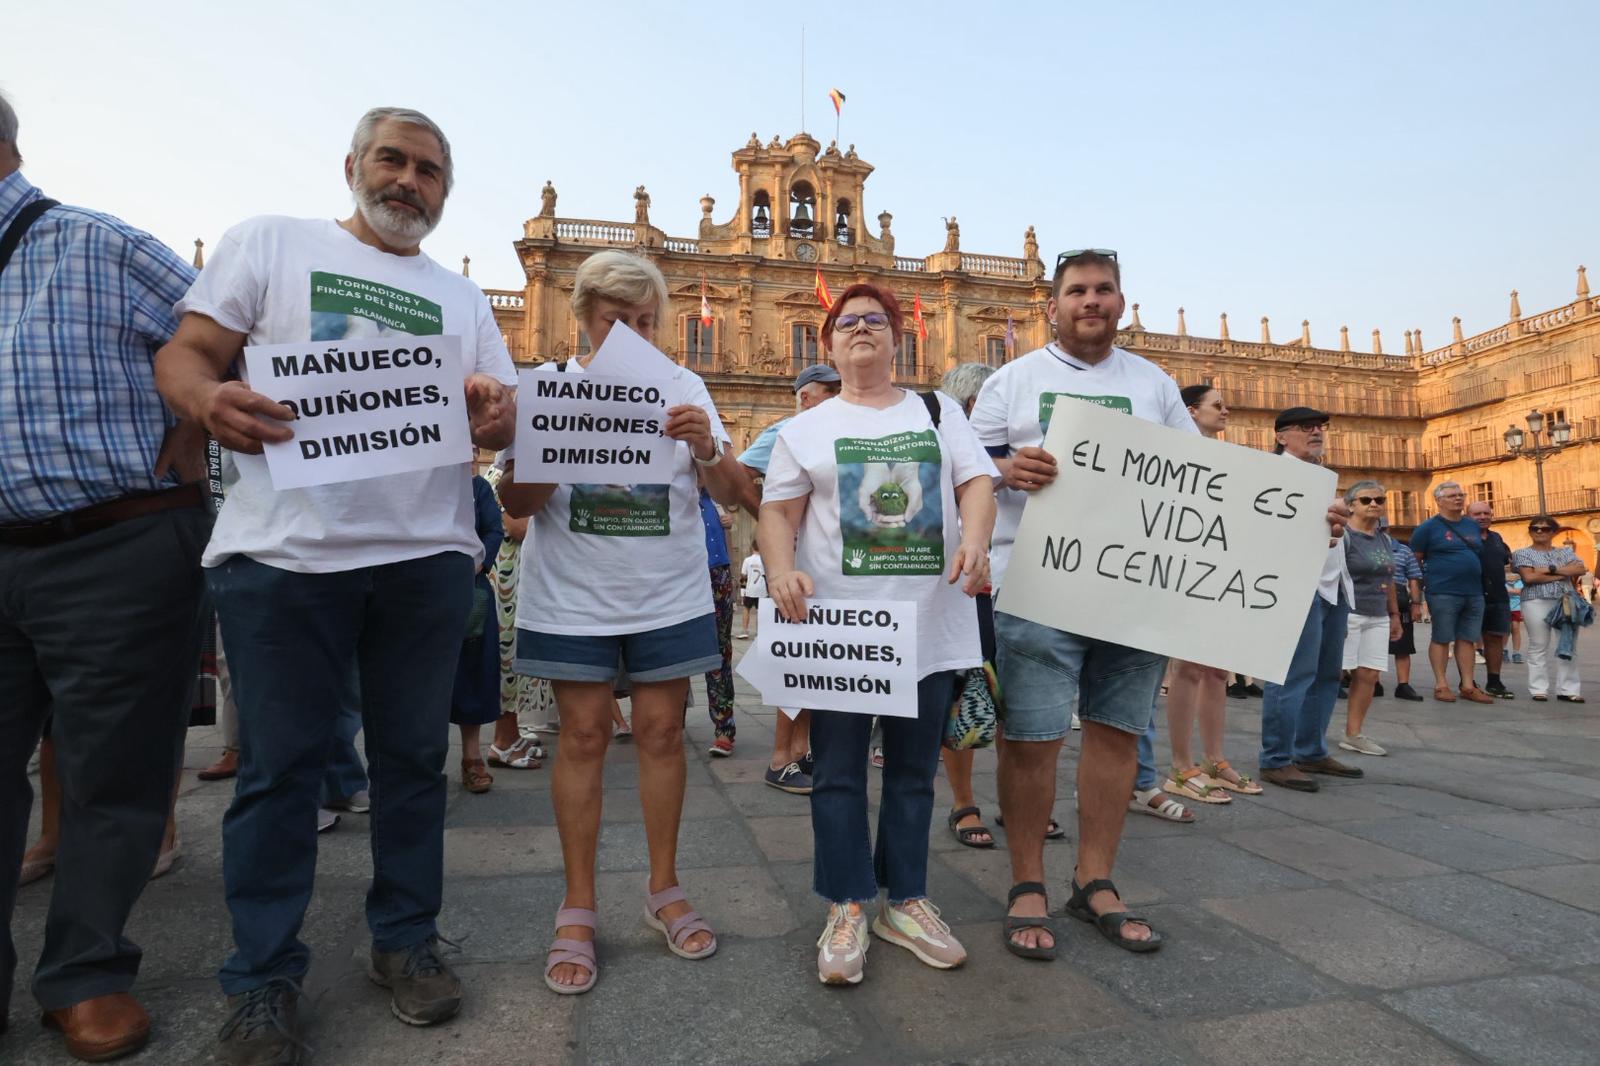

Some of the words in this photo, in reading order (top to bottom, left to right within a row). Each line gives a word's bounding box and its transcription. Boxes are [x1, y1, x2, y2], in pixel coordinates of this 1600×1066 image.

[316, 285, 361, 299] FINCAS
[364, 294, 386, 307] DEL
[388, 302, 440, 323] ENTORNO
[336, 278, 411, 303] TORNADIZOS
[353, 306, 407, 330] SALAMANCA
[272, 346, 442, 378] MAÑUECO,
[537, 379, 666, 408] MAÑUECO,
[531, 413, 665, 438] QUIÑONES,
[299, 422, 442, 460] DIMISIÓN
[852, 434, 911, 446] TORNADIZOS
[893, 440, 937, 453] ENTORNO
[542, 446, 651, 465] DIMISIÓN
[1072, 439, 1106, 472] EL
[1121, 447, 1228, 502] MOMTE
[1253, 487, 1305, 519] ES
[1140, 498, 1228, 552] VIDA
[882, 562, 940, 570] CONTAMINACIÓN
[1041, 535, 1083, 573] NO
[1096, 543, 1280, 610] CENIZAS
[774, 605, 899, 632] MÑUECO,
[770, 639, 902, 667] QUIÑONES,
[784, 674, 892, 695] DIMISIÓN
